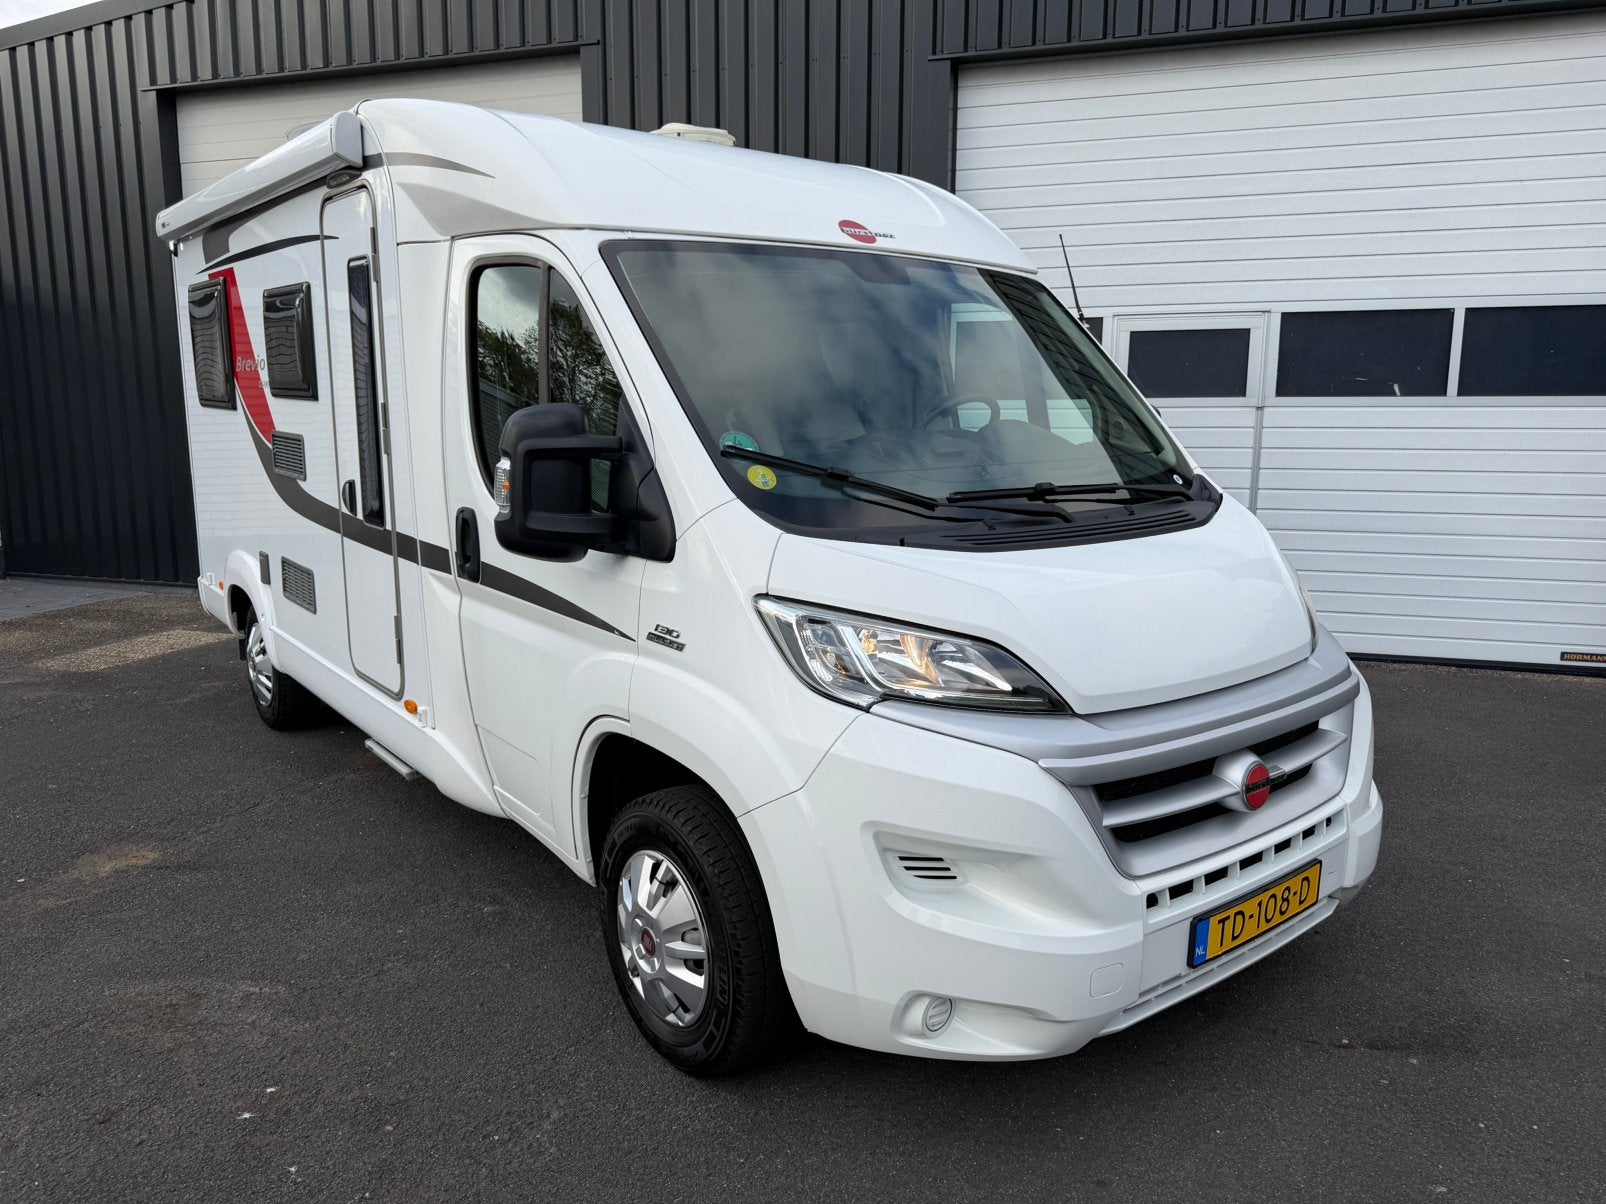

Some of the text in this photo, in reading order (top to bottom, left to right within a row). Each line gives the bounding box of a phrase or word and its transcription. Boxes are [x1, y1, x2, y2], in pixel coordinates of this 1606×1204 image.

[236, 354, 266, 372] Brevio
[1217, 875, 1311, 948] TD-108-D
[1194, 945, 1206, 957] NL
